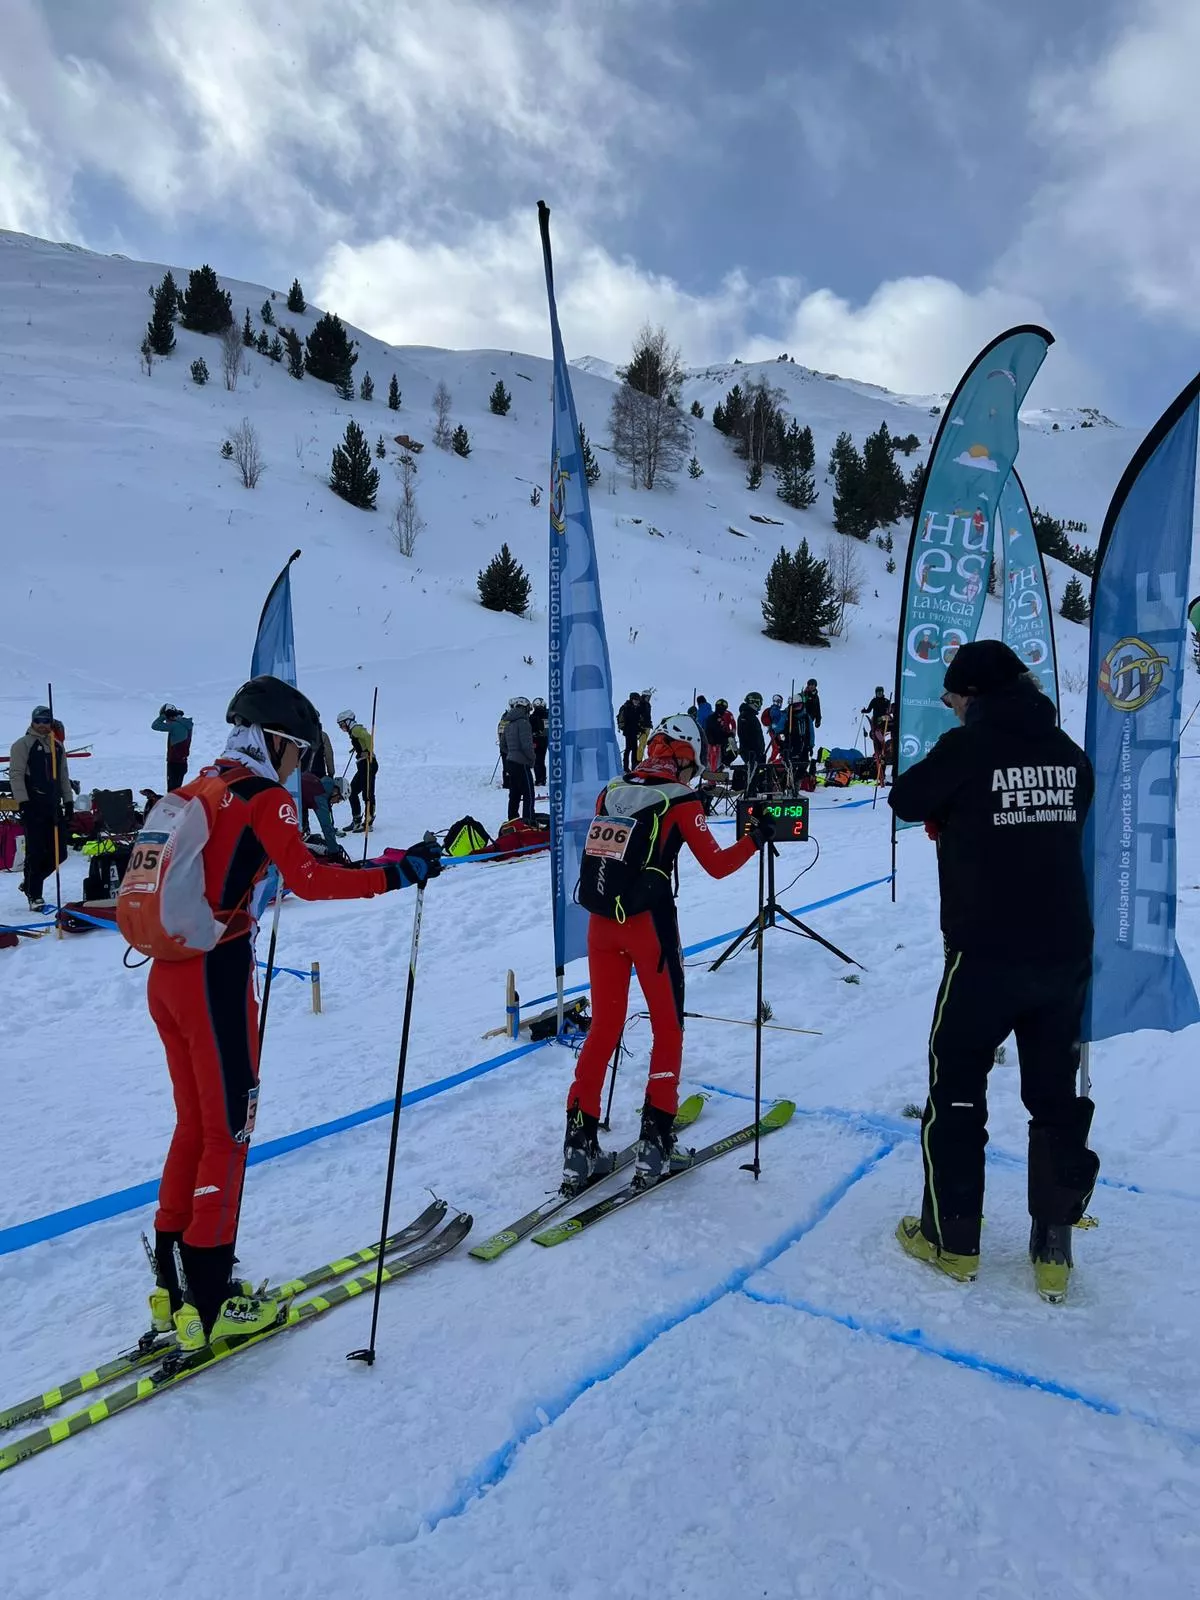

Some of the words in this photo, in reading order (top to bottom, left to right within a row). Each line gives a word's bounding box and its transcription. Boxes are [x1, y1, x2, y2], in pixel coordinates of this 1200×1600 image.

[550, 547, 560, 633] montaña
[549, 639, 560, 663] de
[550, 669, 564, 752] deportes
[551, 757, 563, 784] los
[991, 766, 1077, 792] ARBITRO
[1120, 775, 1132, 791] de
[1002, 789, 1074, 808] FEDME
[793, 821, 803, 835] 2
[993, 807, 1026, 826] ESQUÍ
[1119, 793, 1133, 848] deportes
[589, 825, 628, 843] 306
[1119, 851, 1130, 868] los
[1117, 871, 1130, 942] impulsando
